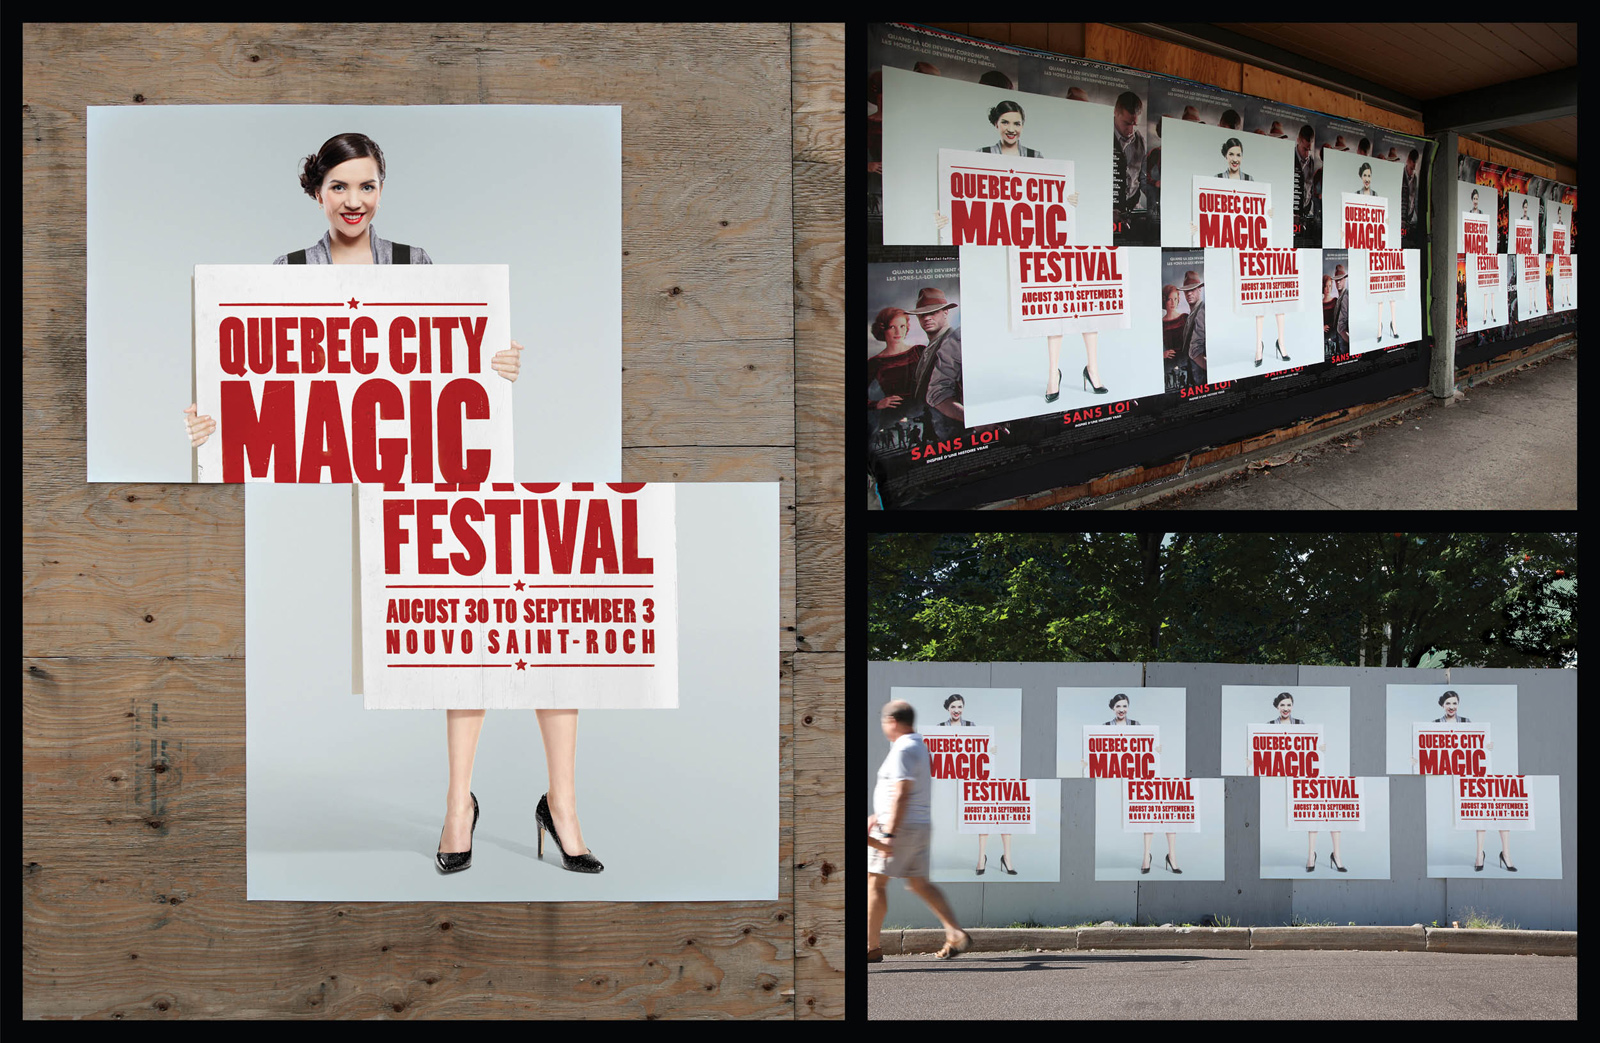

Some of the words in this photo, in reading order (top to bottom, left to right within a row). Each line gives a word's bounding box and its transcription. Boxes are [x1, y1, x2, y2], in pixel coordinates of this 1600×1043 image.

[951, 172, 1022, 201] QUEBEC
[1026, 178, 1065, 203] CITY
[1199, 193, 1240, 214] QUEBEC
[1243, 196, 1266, 215] CITY
[1345, 206, 1370, 222] QUEBEC
[1371, 208, 1385, 223] CITY
[951, 200, 1067, 246] MAGIC
[1200, 214, 1267, 248] MAGIC
[1345, 223, 1385, 250] MAGIC
[1464, 234, 1488, 254] MAGIC
[1020, 251, 1122, 283] FESTIVAL
[1239, 252, 1298, 276] FESTIVAL
[1370, 252, 1405, 271] FESTIVAL
[1022, 292, 1052, 302] AUGUST
[1054, 291, 1063, 301] 30
[1066, 290, 1074, 300] TO
[1077, 289, 1117, 300] SEPTEMBER
[1119, 289, 1123, 298] 3
[1241, 282, 1259, 291] AUGUST
[1242, 292, 1262, 300] NOUVO
[1022, 304, 1058, 315] NOUVO
[1064, 300, 1123, 313] SAINT-ROCH
[219, 316, 378, 377] QUEBEC
[389, 316, 487, 374] CITY
[1332, 353, 1349, 364] SANS
[1181, 384, 1209, 398] SANS
[1064, 407, 1102, 424] SANS
[1109, 401, 1130, 415] LOI
[220, 378, 491, 482] MAGIC
[911, 438, 963, 460] SANS
[971, 429, 999, 446] LOI
[383, 497, 653, 576] FESTIVAL
[386, 598, 459, 624] AUGUST
[465, 598, 489, 624] 30
[494, 598, 518, 624] TO
[524, 598, 635, 624] SEPTEMBER
[642, 598, 654, 623] 3
[386, 629, 473, 654] NOUVO
[488, 629, 655, 654] SAINT-ROCH
[965, 739, 989, 752] CITY
[1089, 738, 1128, 752] QUEBEC
[1130, 738, 1154, 752] CITY
[1253, 736, 1292, 750] QUEBEC
[1294, 737, 1318, 750] CITY
[1419, 734, 1458, 749] QUEBEC
[1460, 734, 1485, 748] CITY
[1089, 753, 1155, 778] MAGIC
[1253, 751, 1319, 776] MAGIC
[1419, 749, 1486, 775] MAGIC
[964, 782, 1030, 801] FESTIVAL
[1128, 781, 1194, 800] FESTIVAL
[1293, 779, 1359, 798] FESTIVAL
[1460, 778, 1528, 798] FESTIVAL
